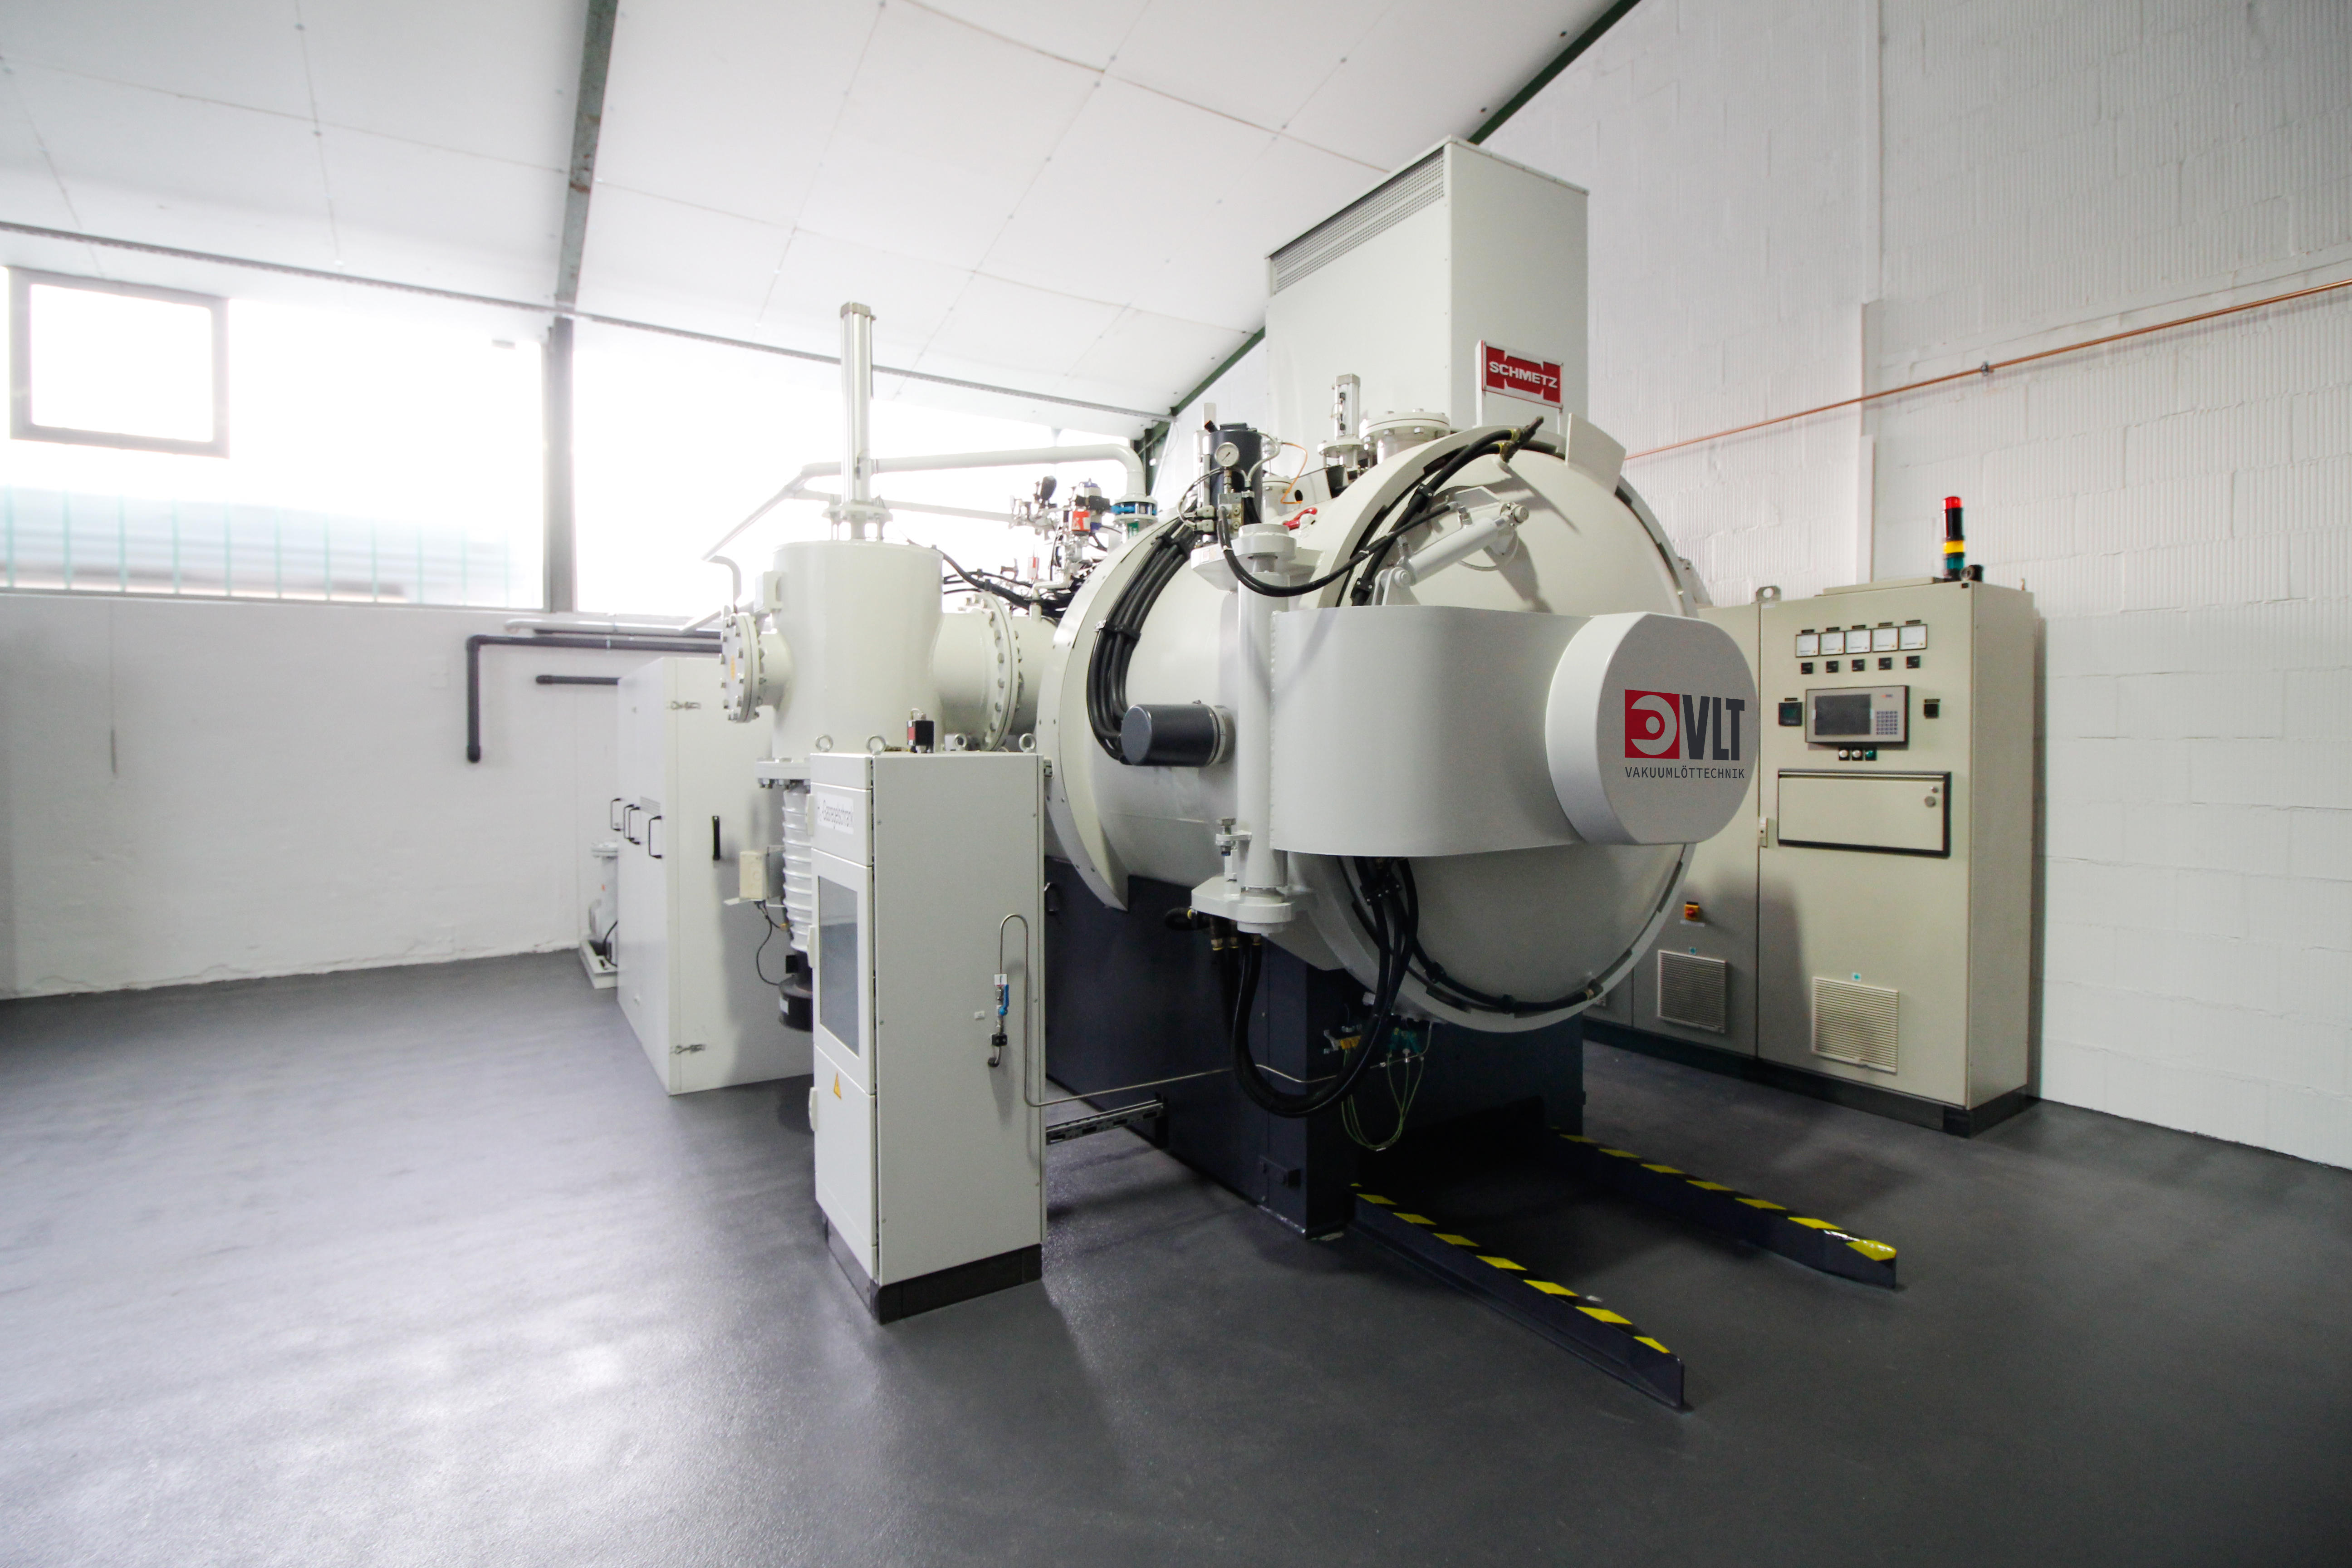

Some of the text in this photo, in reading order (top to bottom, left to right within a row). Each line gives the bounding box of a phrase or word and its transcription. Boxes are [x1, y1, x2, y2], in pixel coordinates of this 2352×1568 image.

[1489, 362, 1558, 388] SCHMETZ
[1682, 695, 1745, 761] VLT
[1625, 765, 1744, 779] VAKUUMLÖTTECHNIK
